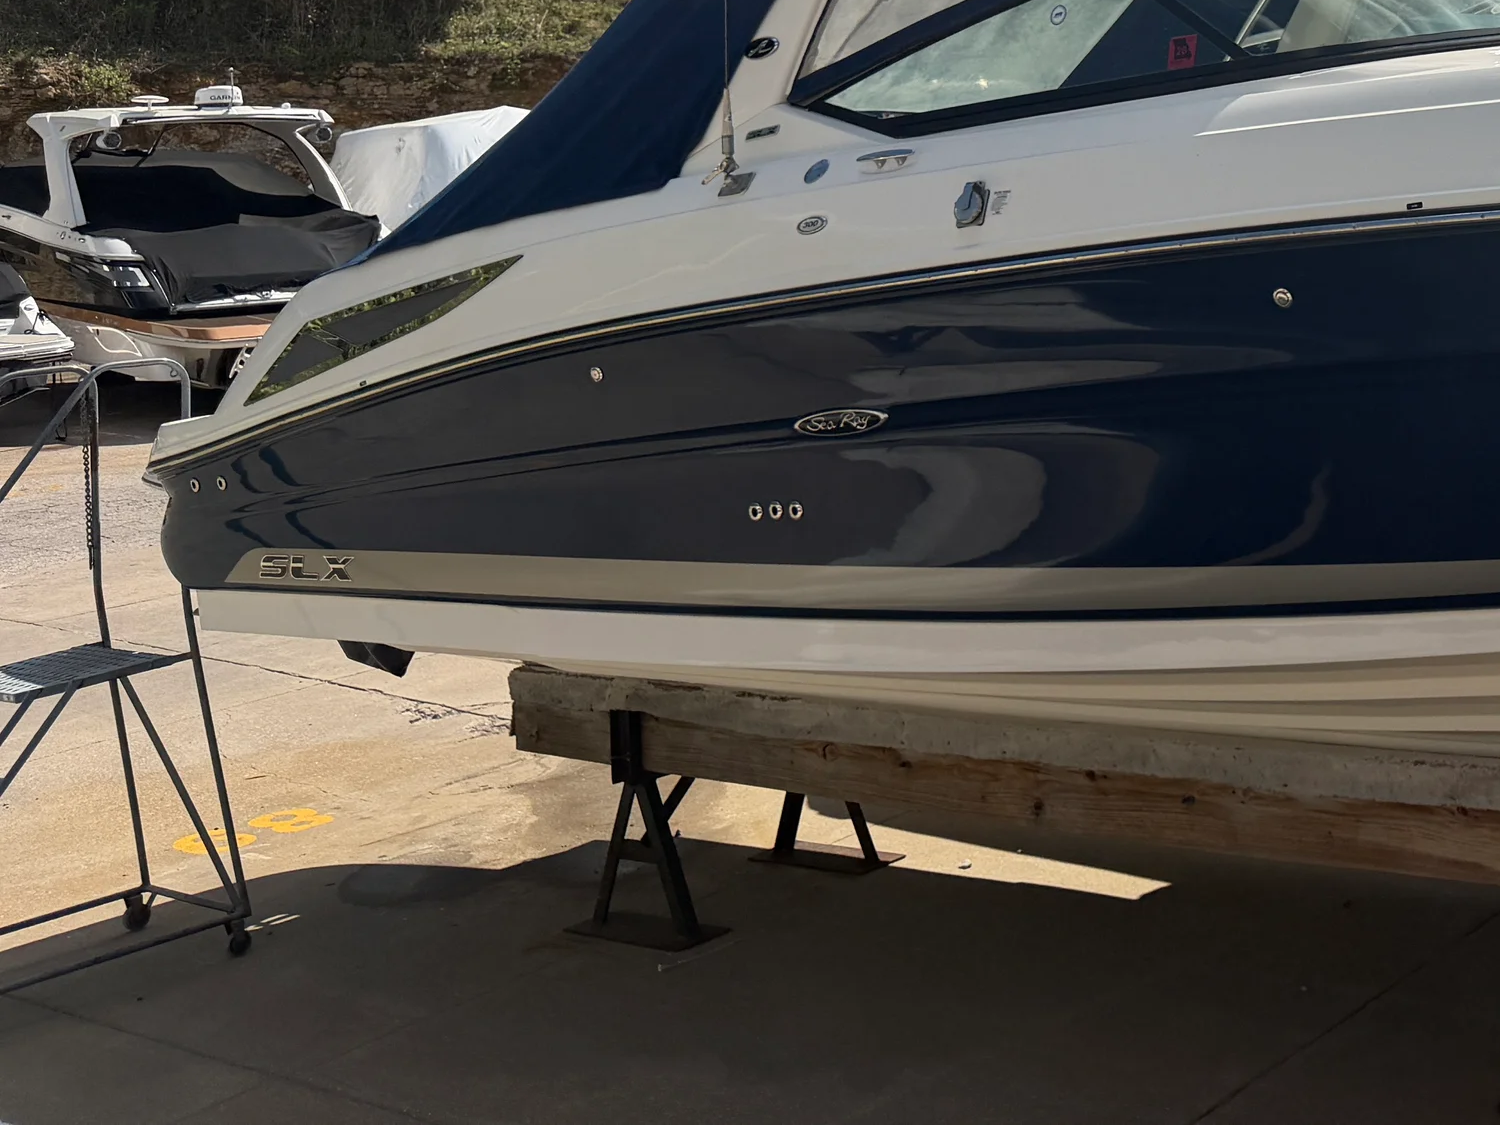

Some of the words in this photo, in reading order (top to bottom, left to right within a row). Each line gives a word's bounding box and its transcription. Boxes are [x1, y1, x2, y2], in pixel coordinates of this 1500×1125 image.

[806, 416, 837, 432] Sea
[839, 411, 871, 430] Ray
[259, 554, 355, 582] SLX
